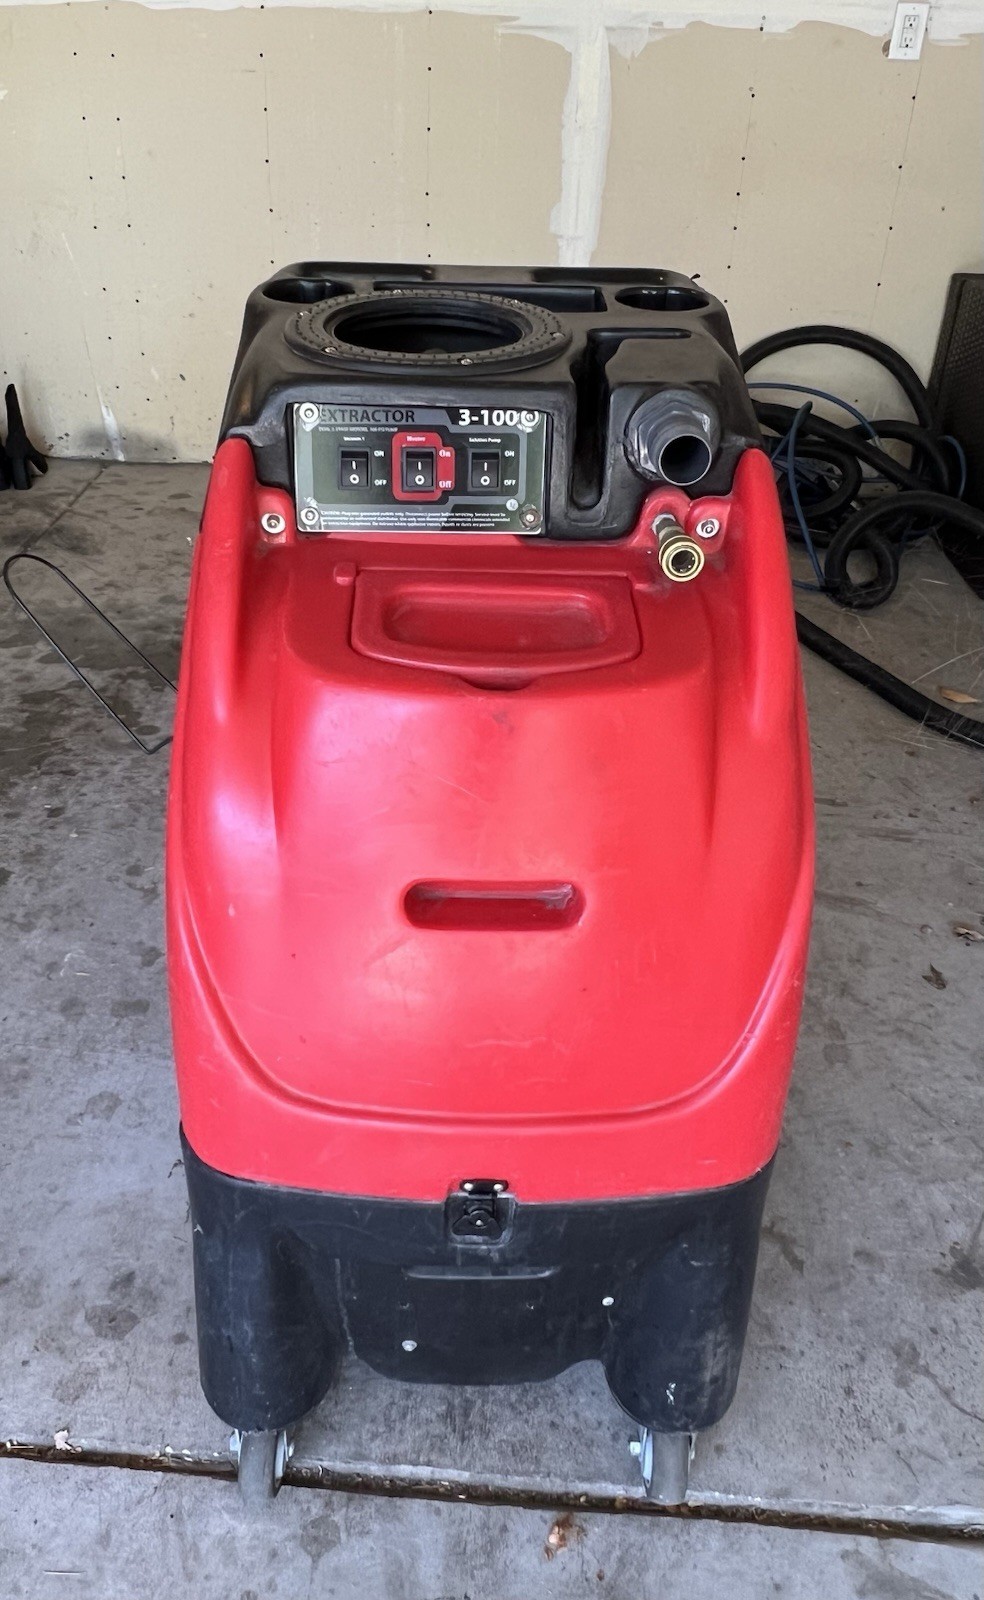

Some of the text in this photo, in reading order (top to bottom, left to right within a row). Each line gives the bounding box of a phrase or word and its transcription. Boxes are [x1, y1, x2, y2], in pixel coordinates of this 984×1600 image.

[320, 408, 415, 422] EXTRACTOR
[438, 449, 451, 457] On
[504, 450, 515, 458] ON
